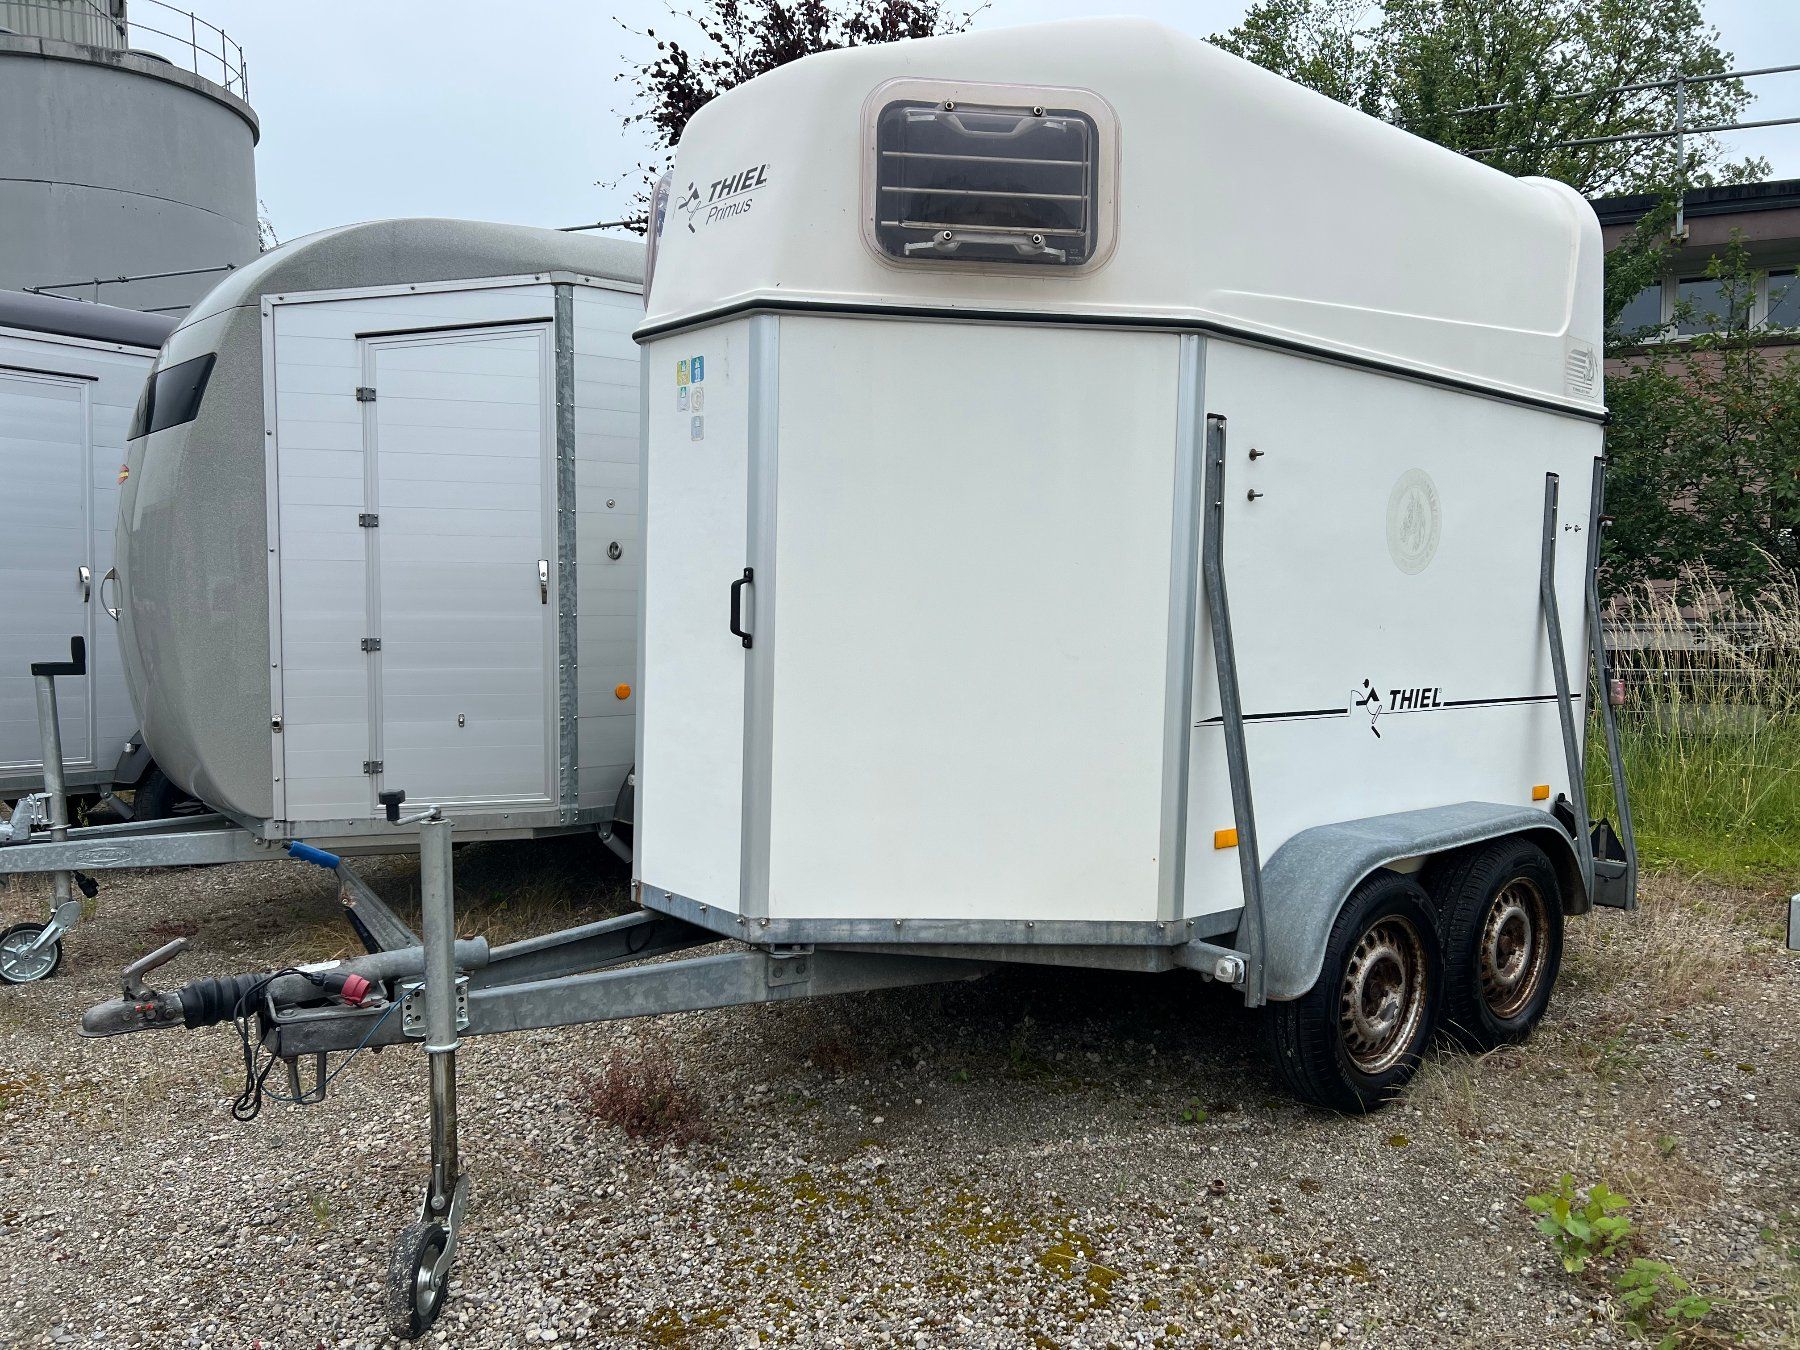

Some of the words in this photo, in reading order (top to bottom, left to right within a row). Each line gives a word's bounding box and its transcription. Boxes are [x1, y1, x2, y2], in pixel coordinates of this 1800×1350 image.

[708, 163, 768, 203] THIEL
[705, 198, 753, 226] Primus
[1389, 687, 1442, 711] THIEL
